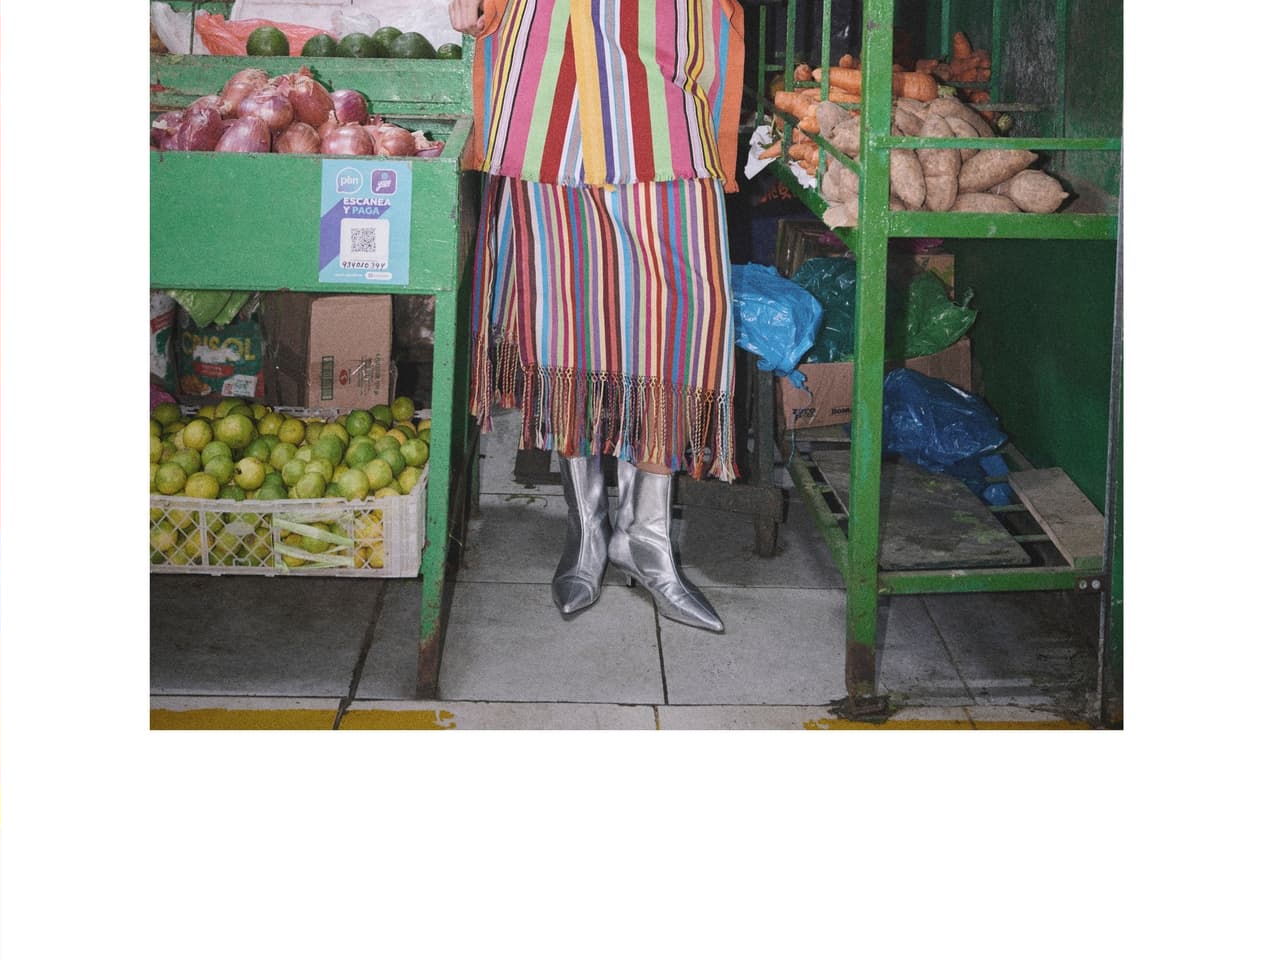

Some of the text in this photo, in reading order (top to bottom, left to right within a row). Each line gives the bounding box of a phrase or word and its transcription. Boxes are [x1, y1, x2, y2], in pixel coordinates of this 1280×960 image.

[343, 197, 391, 206] ESCANEA
[343, 206, 380, 215] Y PAGA
